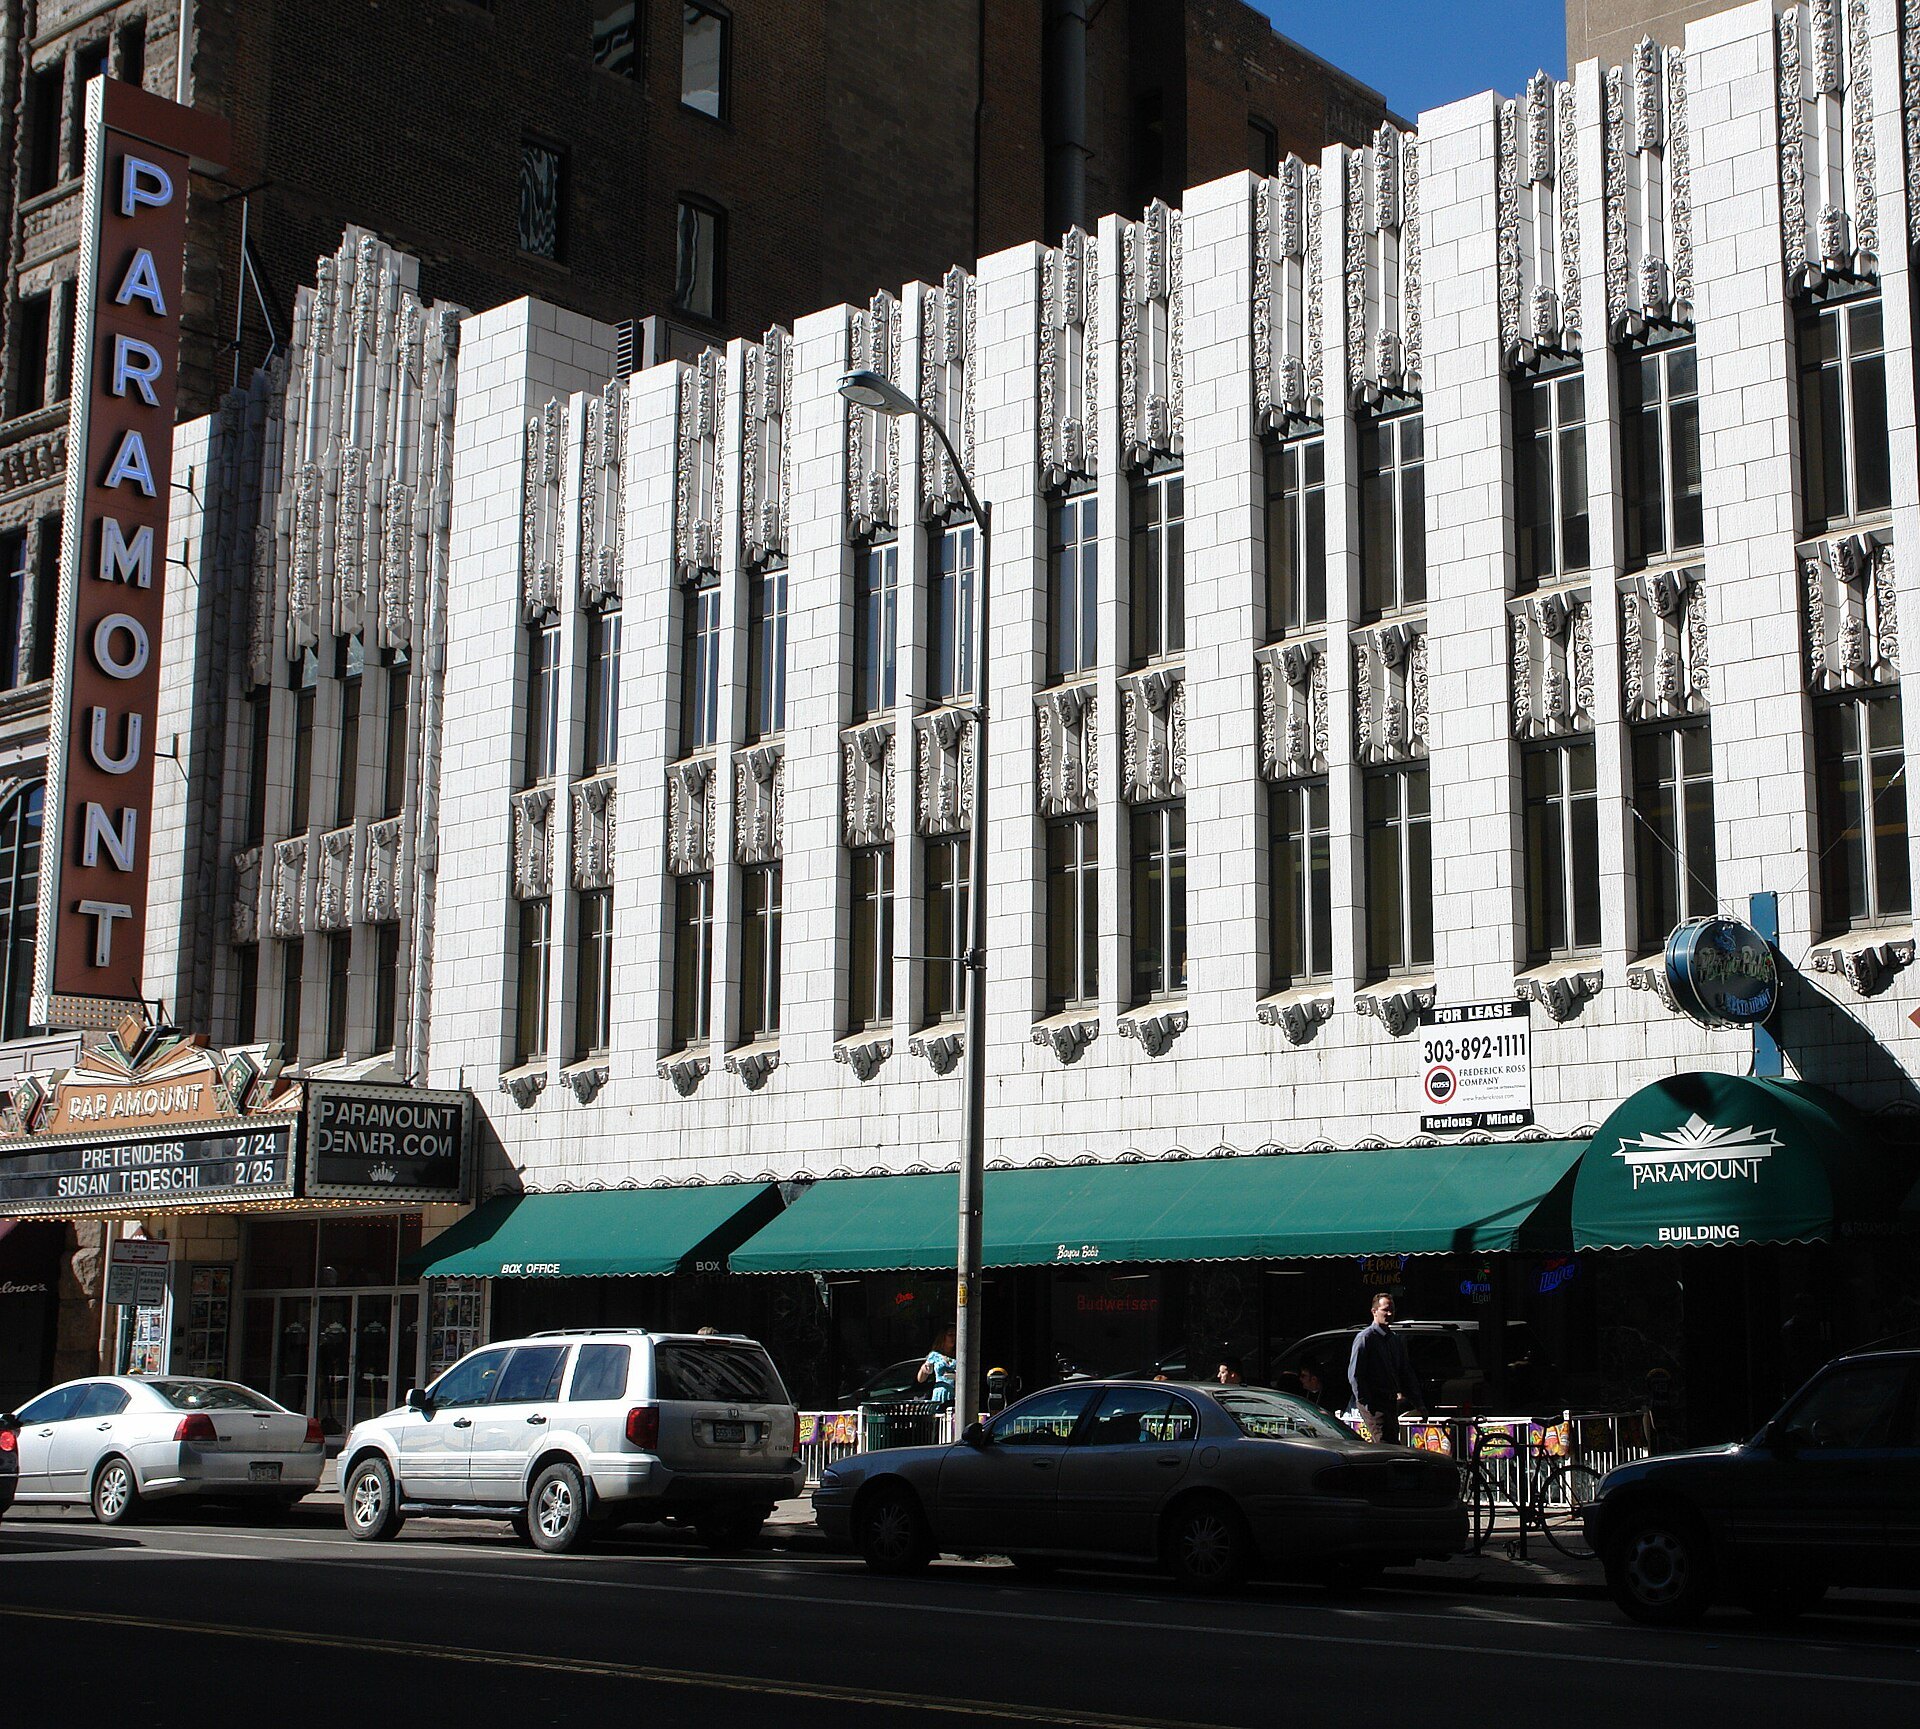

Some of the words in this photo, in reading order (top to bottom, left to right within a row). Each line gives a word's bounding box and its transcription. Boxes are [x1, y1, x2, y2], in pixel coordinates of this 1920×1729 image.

[77, 153, 174, 968] PARAMOUNT
[1434, 1009, 1462, 1022] FOR
[1467, 1003, 1512, 1020] LEASE
[1424, 1033, 1526, 1063] 303-892-1111
[1459, 1066, 1503, 1077] FREDERICK
[1505, 1064, 1526, 1074] ROSS
[1431, 1080, 1450, 1089] ROSS
[1459, 1076, 1500, 1087] COMPANY
[68, 1083, 204, 1123] PARAMOUNT
[320, 1101, 456, 1130] PARAMOUNT
[1426, 1116, 1473, 1129] Revious
[1486, 1112, 1524, 1126] Minde
[82, 1142, 185, 1169] PRETENDERS
[236, 1133, 276, 1157] 2/24
[319, 1129, 453, 1157] DENVER.COM
[57, 1173, 110, 1197] SUSAN
[120, 1166, 200, 1193] TEDESCHI
[235, 1160, 274, 1184] 2/25
[1632, 1158, 1763, 1190] PARAMOUNT
[1658, 1224, 1740, 1241] BUILDING
[1056, 1244, 1080, 1260] Bayou
[501, 1263, 522, 1274] BOX
[526, 1263, 561, 1274] OFFICE
[695, 1260, 721, 1272] BOX
[0, 1280, 49, 1294] lowe's
[1077, 1293, 1160, 1312] Budweiser
